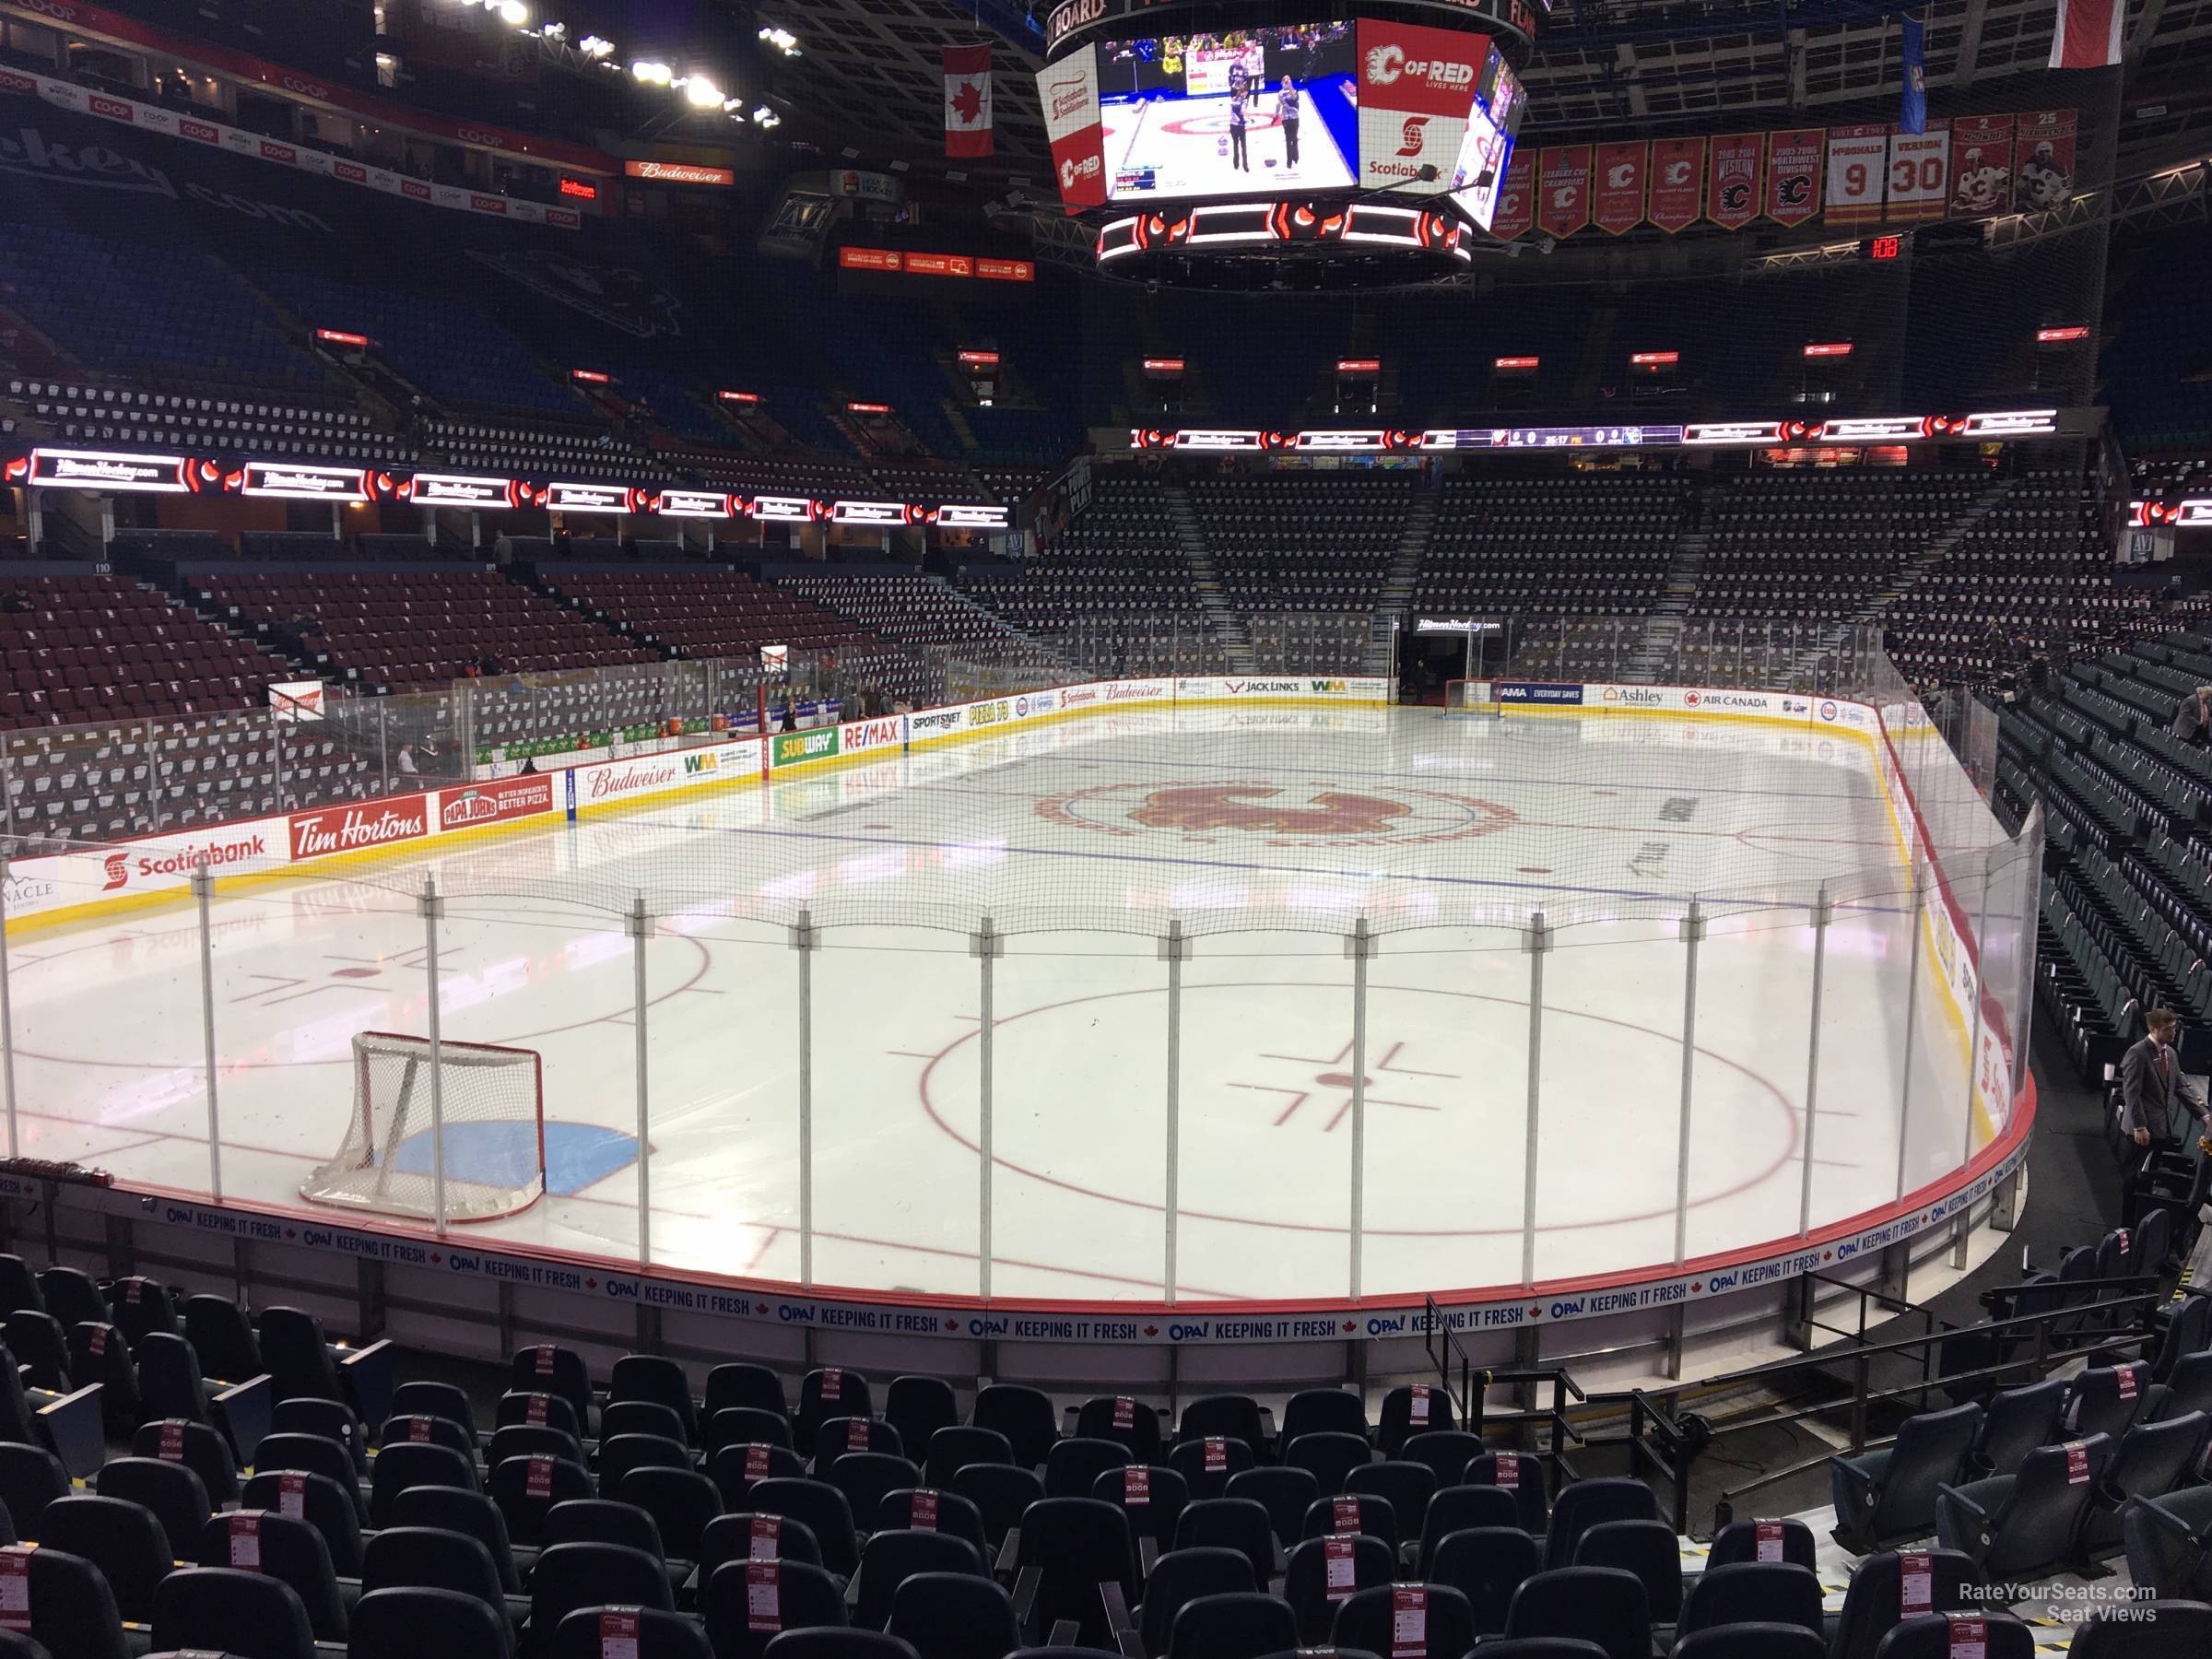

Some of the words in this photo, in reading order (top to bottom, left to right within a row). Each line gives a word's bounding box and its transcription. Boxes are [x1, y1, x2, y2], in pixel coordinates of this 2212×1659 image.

[1405, 60, 1428, 76] OF
[1429, 60, 1474, 84] RED
[1426, 81, 1447, 89] LIVES
[1980, 118, 1989, 130] 2
[2039, 112, 2056, 125] 25
[638, 161, 722, 182] Budweiser
[1082, 154, 1100, 173] RED
[1370, 160, 1442, 180] Scotiabk
[1845, 163, 1866, 195] 9
[1892, 157, 1943, 192] 30
[56, 459, 159, 482] HitmenHockey.com
[95, 562, 111, 573] 110
[1106, 683, 1162, 701] Budweiser
[1246, 681, 1269, 692] JACK
[1312, 680, 1346, 691] WM
[1501, 688, 1527, 698] AMA
[1618, 688, 1663, 704] Ashley
[1703, 695, 1722, 705] AIR
[1724, 697, 1768, 708] CANADA
[912, 712, 961, 730] SPORTSNET
[970, 703, 994, 726] PIZZA
[844, 721, 898, 749] RE/MAX
[781, 733, 831, 759] SUBWAY
[685, 753, 718, 773] WM
[587, 765, 677, 798] Budweiser
[445, 801, 466, 823] PAPA
[499, 798, 526, 811] BETTER
[294, 817, 336, 855] Tim
[139, 834, 265, 877] Scotiabank
[196, 1212, 236, 1231] KEEPING
[238, 1218, 248, 1233] IT
[250, 1219, 282, 1239] FRESH
[1863, 1232, 1890, 1251] KEEPING
[1892, 1227, 1900, 1240] IT
[1900, 1217, 1920, 1237] FRESH
[335, 1234, 379, 1255] KEEPING
[381, 1242, 391, 1256] IT
[394, 1244, 426, 1264] FRESH
[485, 1260, 530, 1280] KEEPING
[533, 1268, 543, 1282] IT
[546, 1270, 580, 1289] FRESH
[1742, 1262, 1781, 1285] KEEPING
[1783, 1259, 1791, 1275] IT
[1794, 1253, 1820, 1272] FRESH
[645, 1284, 692, 1307] KEEPING
[696, 1294, 708, 1309] IT
[712, 1296, 749, 1314] FRESH
[1590, 1290, 1637, 1312] KEEPING
[1641, 1288, 1651, 1305] IT
[1653, 1283, 1687, 1302] FRESH
[821, 1308, 876, 1328] KEEPING
[879, 1313, 892, 1329] IT
[896, 1315, 938, 1333] FRESH
[1469, 1311, 1481, 1326] IT
[1485, 1307, 1524, 1326] FRESH
[1015, 1321, 1072, 1338] KEEPING
[1077, 1323, 1089, 1338] IT
[1094, 1324, 1136, 1339] FRESH
[1216, 1322, 1272, 1339] KEEPING
[1277, 1322, 1289, 1337] IT
[1293, 1321, 1335, 1336] FRESH
